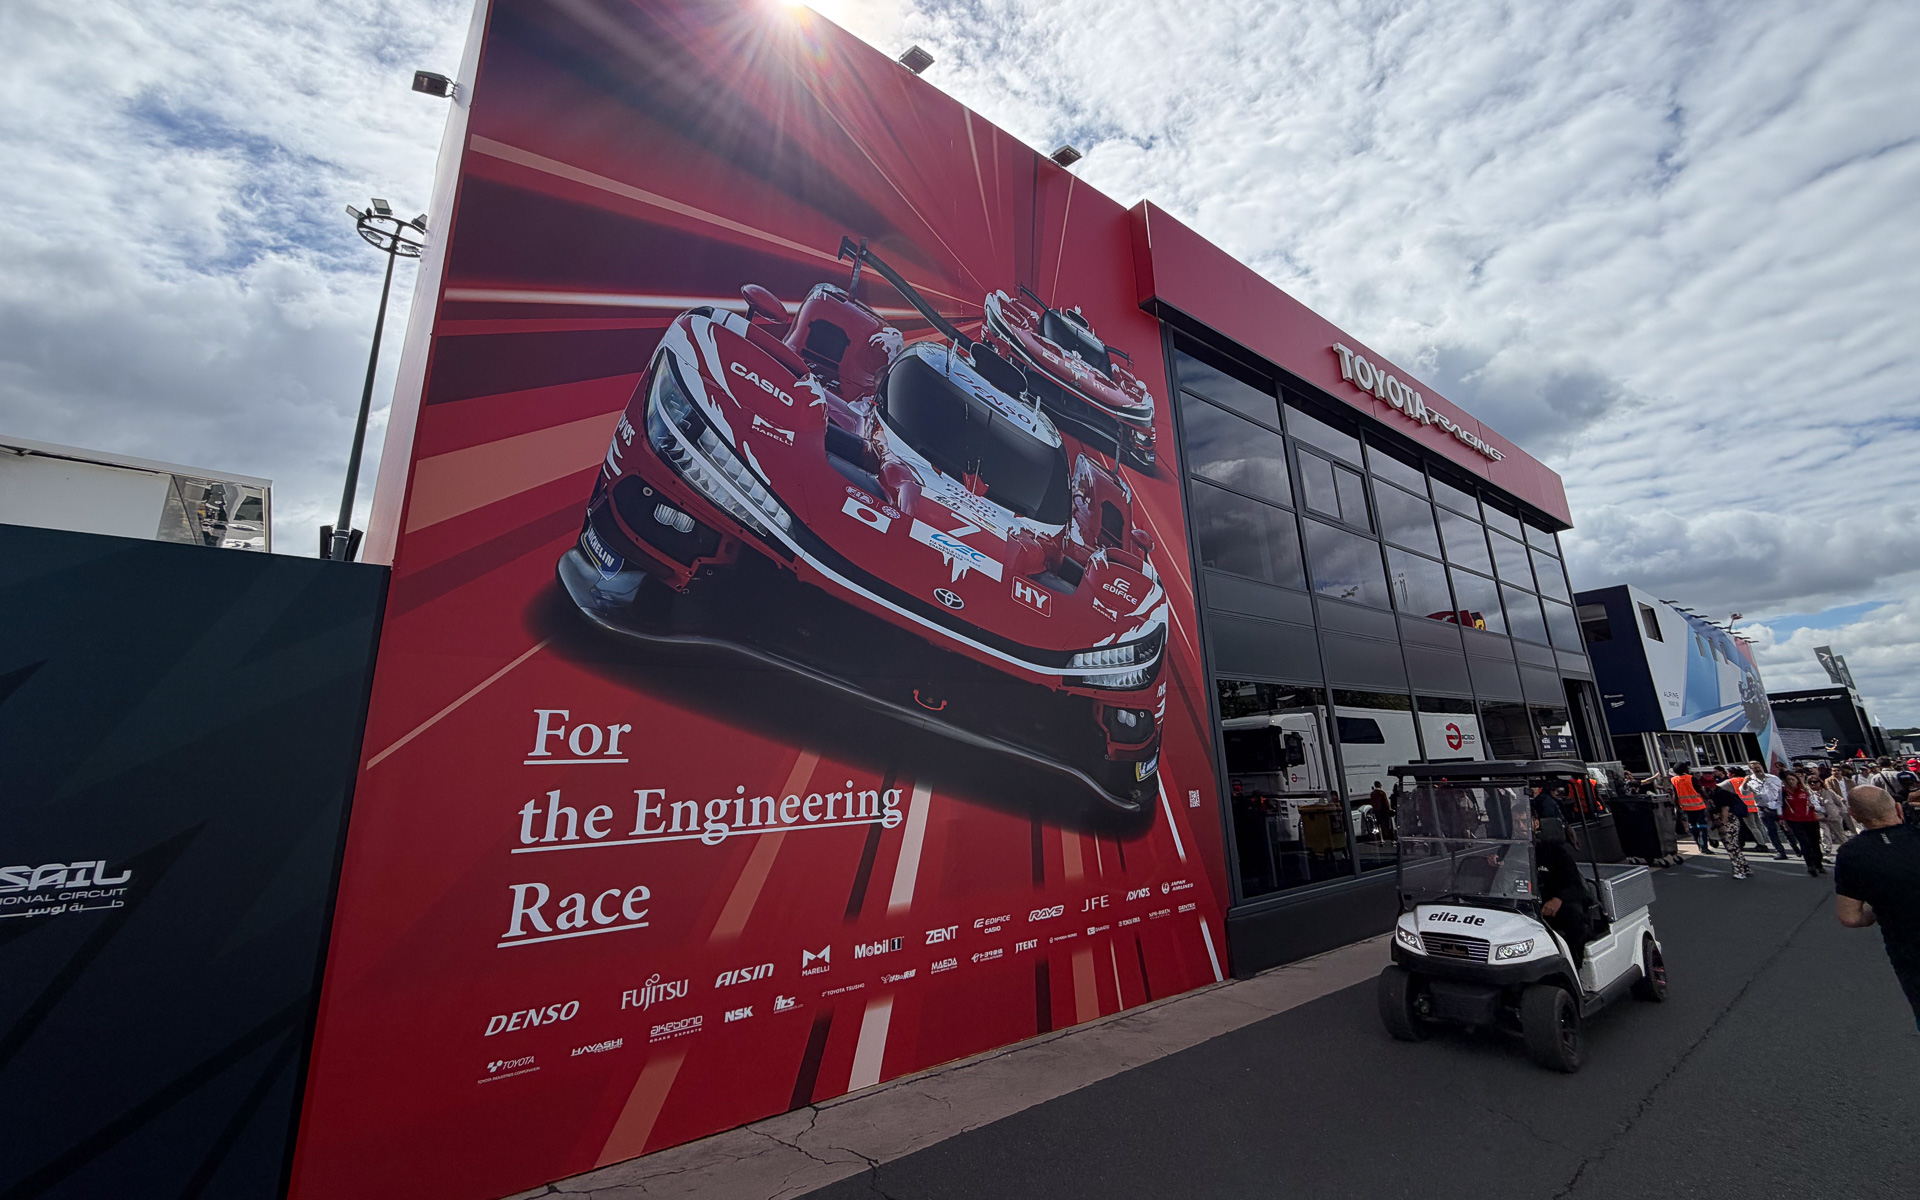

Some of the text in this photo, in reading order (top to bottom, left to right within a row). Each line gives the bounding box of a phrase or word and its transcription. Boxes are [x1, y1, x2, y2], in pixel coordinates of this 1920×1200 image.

[729, 361, 794, 407] CASIO
[954, 371, 1032, 425] DENSO
[1332, 342, 1507, 462] TOYOTA RACING
[751, 425, 793, 447] MARELLI
[946, 512, 982, 538] 7
[1015, 581, 1049, 609] HY
[1102, 583, 1138, 606] EDIFICE
[1767, 694, 1842, 705] ORVETTE
[527, 709, 632, 756] For
[517, 779, 904, 846] the Engineering
[58, 888, 127, 900] CIRCUIT
[1081, 894, 1109, 912] JFE
[1126, 887, 1150, 902] ADVICS
[500, 882, 651, 938] Race
[984, 914, 1011, 926] EDIFICE
[1028, 904, 1064, 922] RAYS
[925, 925, 959, 945] ZENT
[984, 925, 1001, 934] CASIO
[854, 939, 889, 959] Mobil
[1015, 938, 1038, 954] JTEKT
[801, 964, 830, 977] MARELLI
[931, 957, 957, 971] MAEDA
[714, 962, 774, 988] AISIN
[621, 974, 689, 1011] FUJITSU
[827, 983, 865, 996] TOYOTA TSUSHO
[485, 1001, 580, 1036] DENSO
[724, 1005, 753, 1023] NSK
[571, 1037, 623, 1056] HAYASHI
[503, 1055, 535, 1070] TOYOTA
